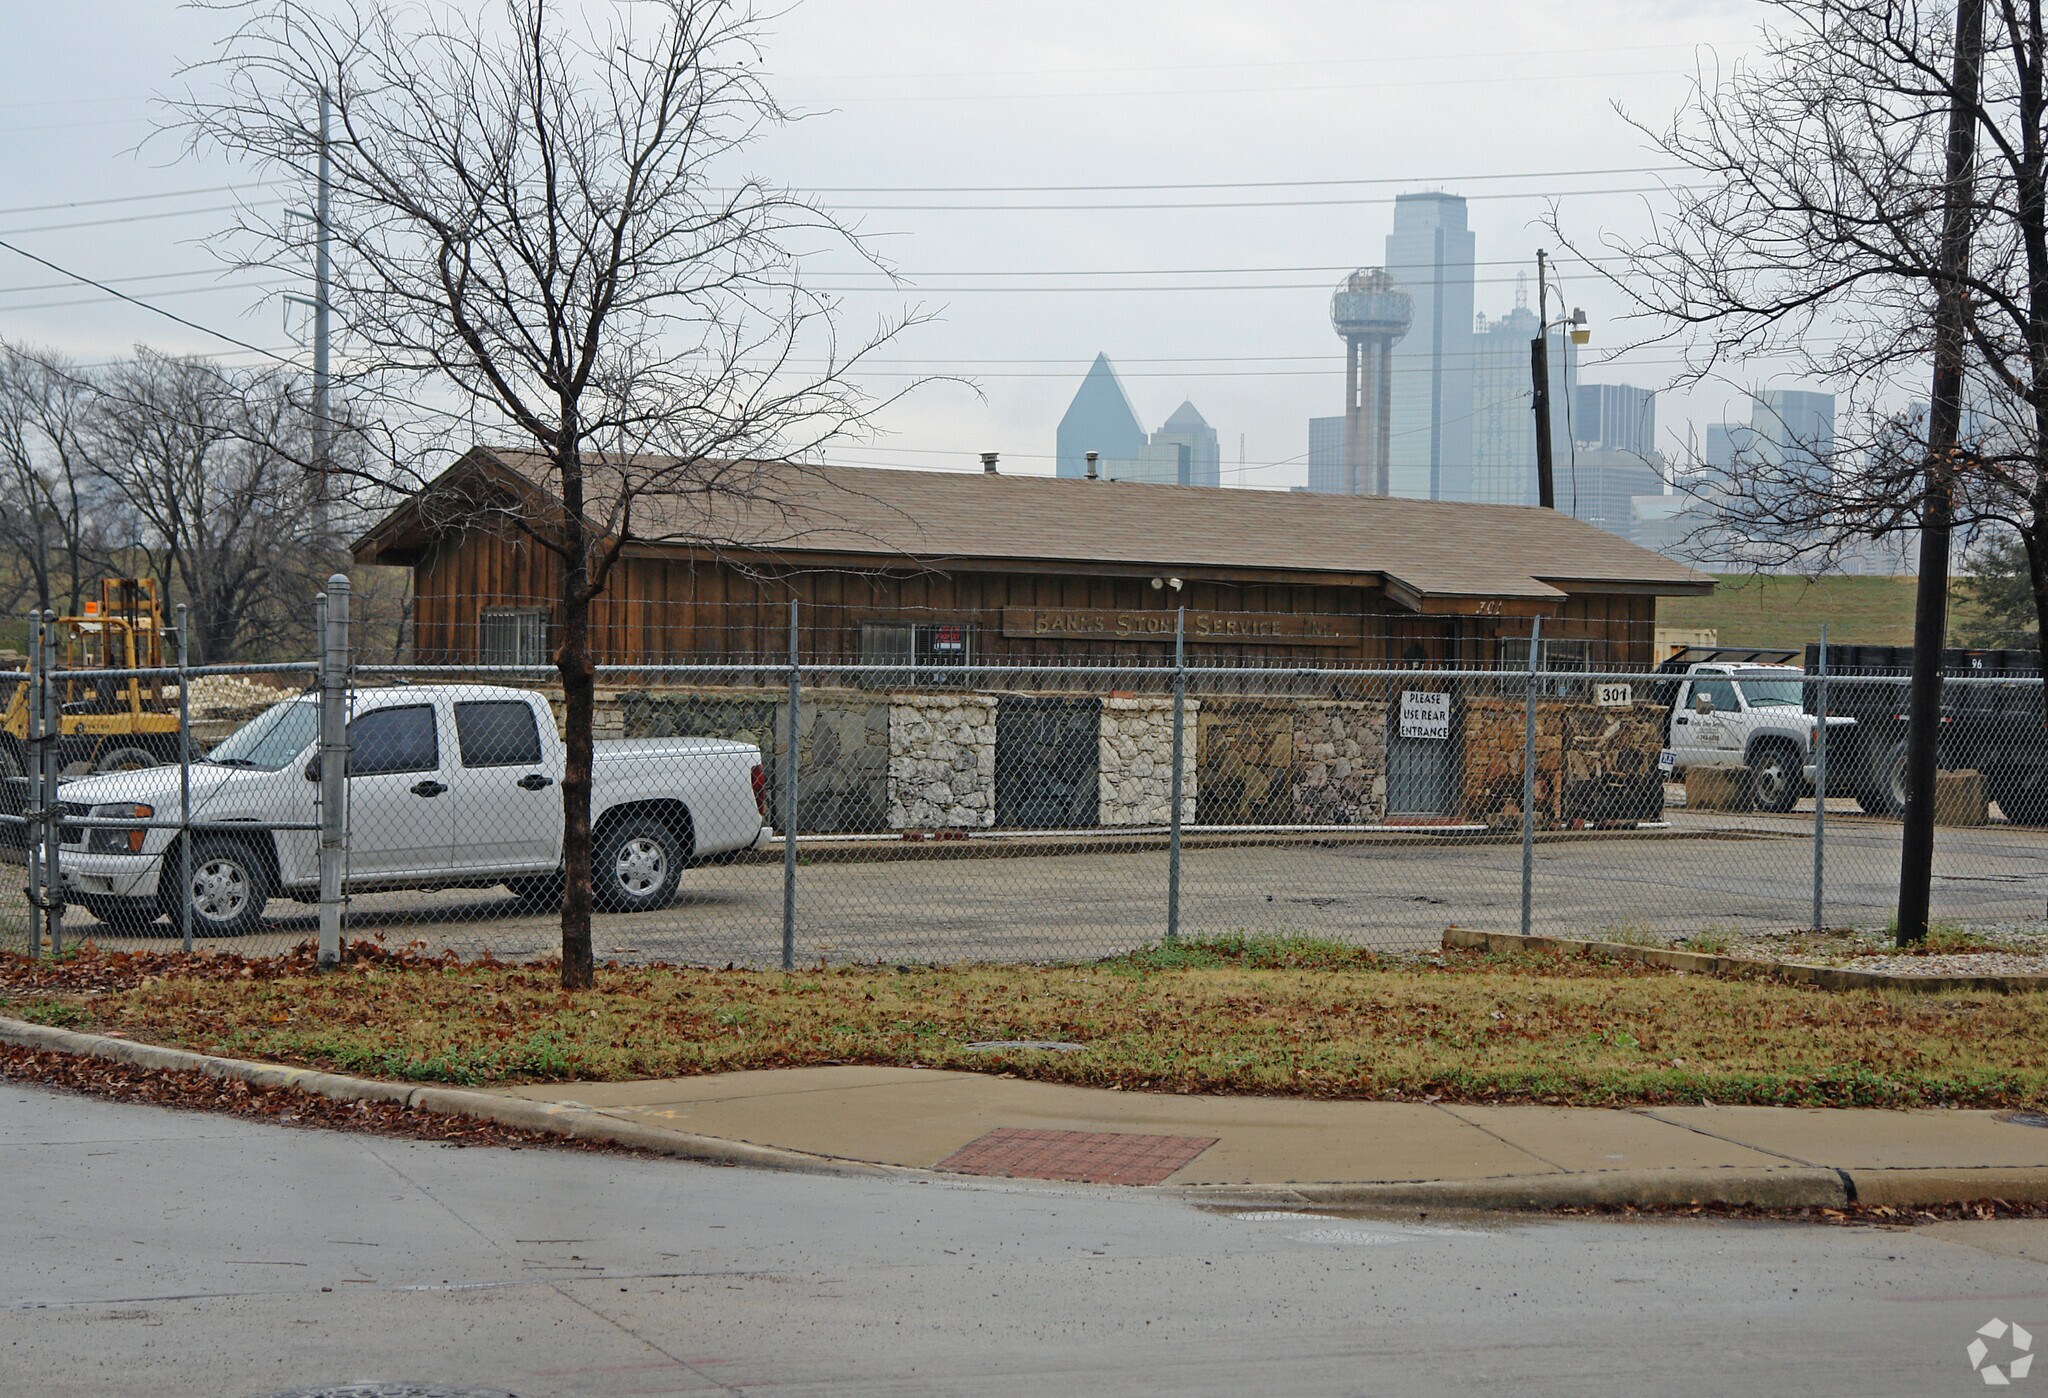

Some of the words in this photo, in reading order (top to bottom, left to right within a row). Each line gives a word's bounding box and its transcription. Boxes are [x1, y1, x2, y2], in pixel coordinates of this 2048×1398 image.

[1971, 658, 1983, 669] 96
[1409, 692, 1441, 704] PLEASE
[1602, 688, 1627, 702] 301
[1403, 709, 1419, 720] USE
[1421, 710, 1446, 721] REAR
[1401, 725, 1448, 737] ENTRANCE
